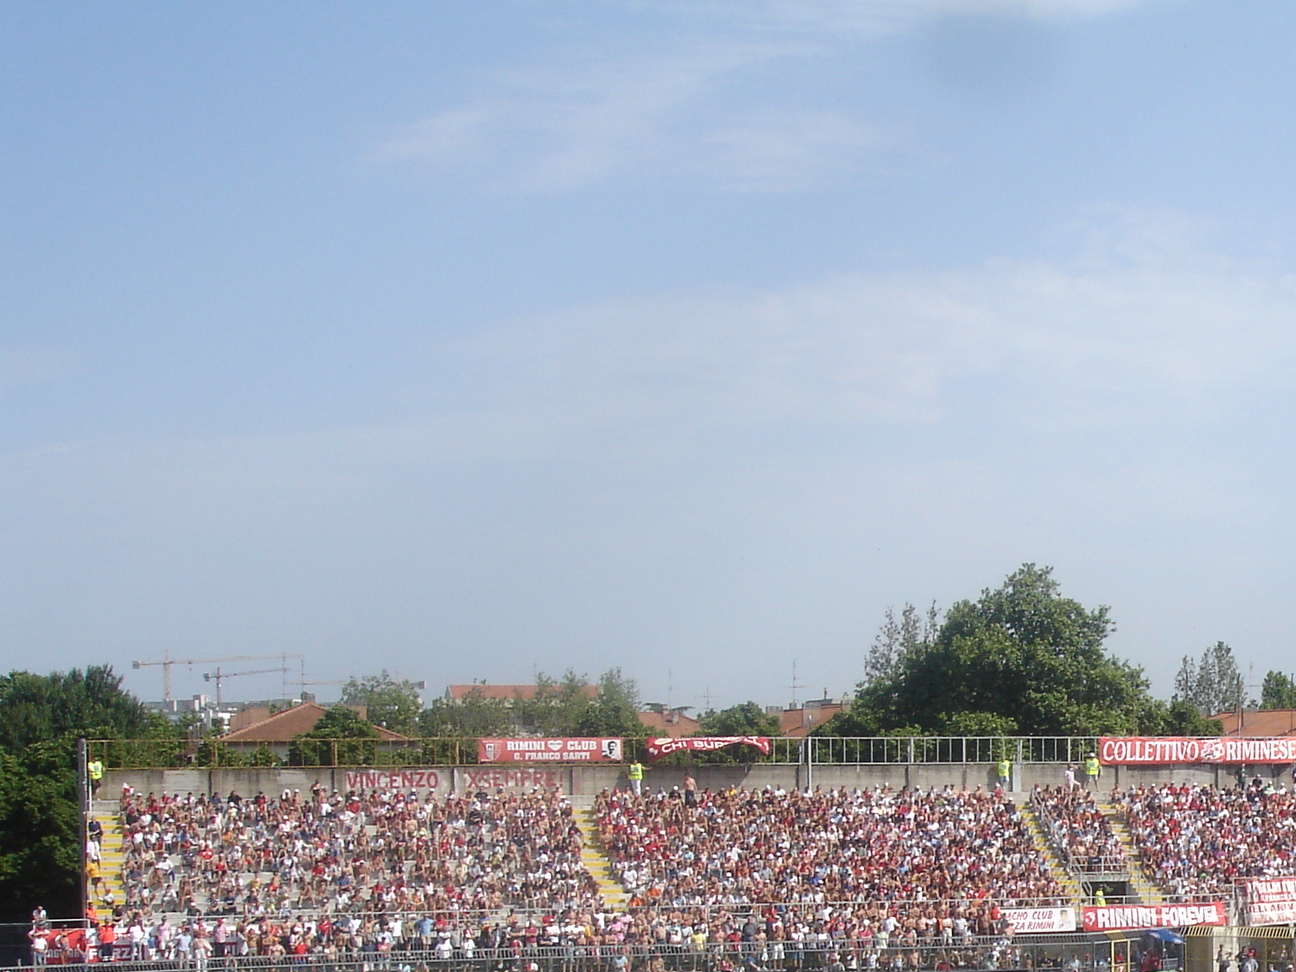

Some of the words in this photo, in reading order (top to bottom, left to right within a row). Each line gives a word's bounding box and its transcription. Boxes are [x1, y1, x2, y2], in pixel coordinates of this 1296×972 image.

[507, 740, 545, 751] RIMINI
[567, 740, 598, 750] CLUB
[1103, 740, 1199, 762] COLLETTIVO
[1226, 739, 1296, 760] RIMINESE
[345, 770, 439, 789] VINCENZO
